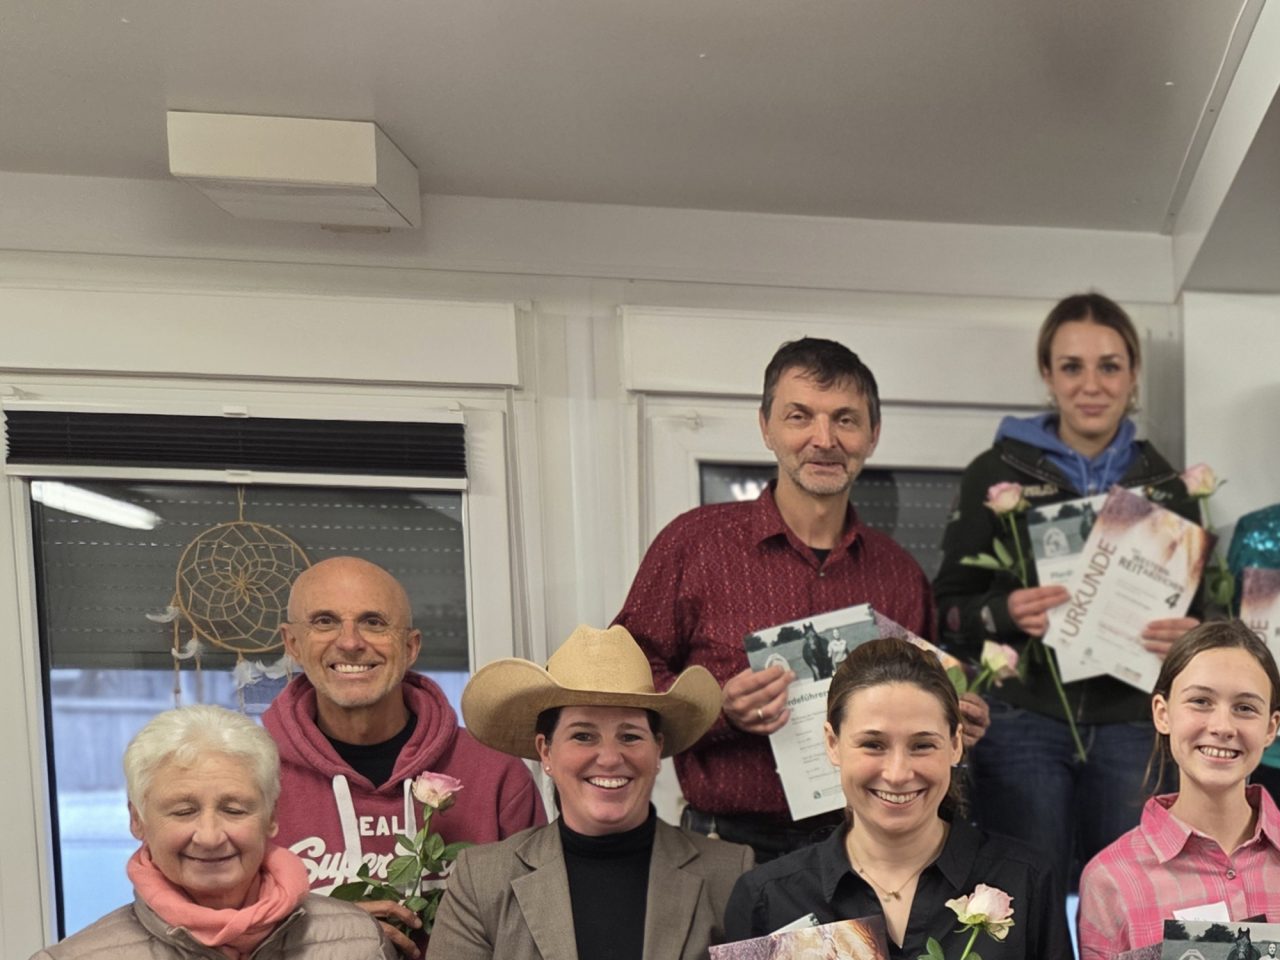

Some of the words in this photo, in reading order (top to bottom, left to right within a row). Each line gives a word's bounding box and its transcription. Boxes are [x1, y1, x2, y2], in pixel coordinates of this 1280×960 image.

[1060, 537, 1117, 637] URKUNDE
[1164, 592, 1181, 610] 4
[359, 815, 406, 836] EAL
